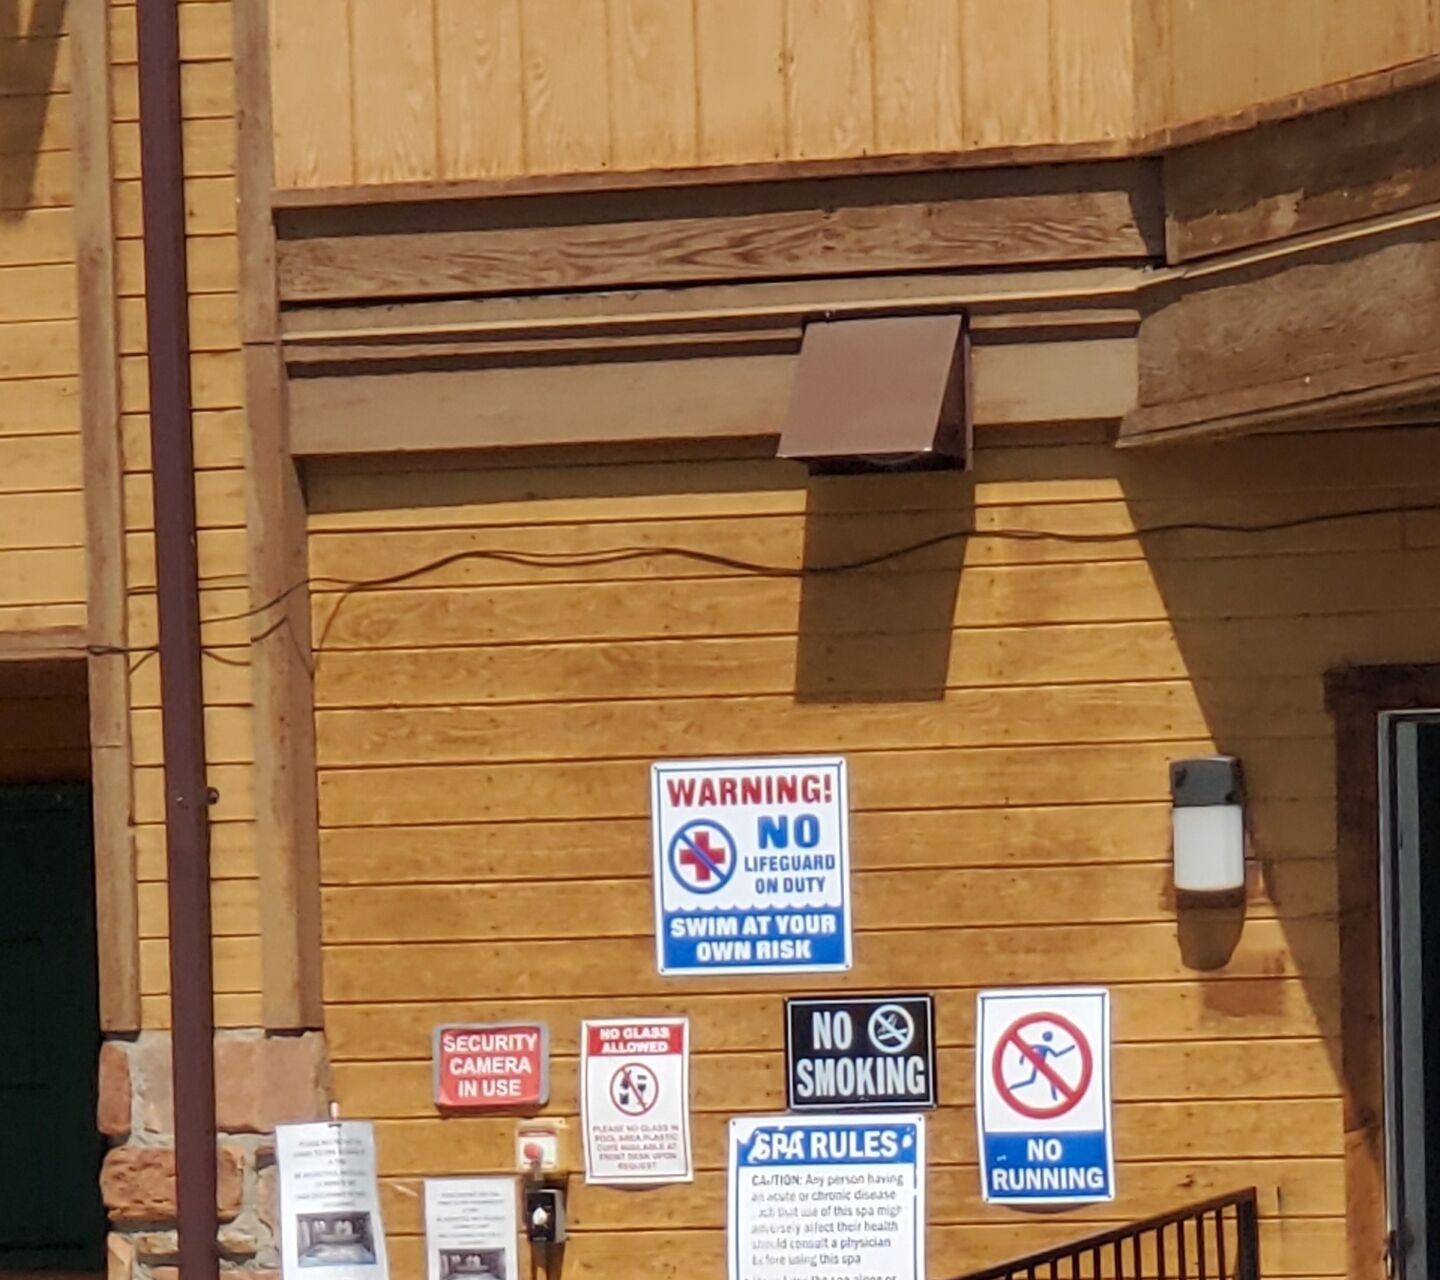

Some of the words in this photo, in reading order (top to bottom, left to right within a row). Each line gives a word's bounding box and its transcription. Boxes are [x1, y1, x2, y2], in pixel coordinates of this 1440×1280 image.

[666, 774, 832, 807] WARNING!
[757, 814, 820, 849] NO
[744, 854, 835, 872] LIFEGUARD
[755, 877, 777, 894] ON
[783, 876, 826, 893] DUTY
[670, 917, 739, 937] SWIM
[742, 916, 772, 935] AT
[775, 914, 836, 934] YOUR
[696, 942, 750, 961] OWN
[756, 940, 811, 960] RISK
[600, 1028, 620, 1040] NO
[622, 1026, 671, 1039] GLASS
[812, 1010, 853, 1050] NO
[443, 1033, 538, 1052] SECURITY
[601, 1041, 669, 1054] ALLOWED
[449, 1056, 532, 1075] CAMERA
[796, 1055, 926, 1097] SMOKING
[458, 1078, 477, 1097] IN
[483, 1079, 522, 1097] USE
[753, 1131, 805, 1160] SPA
[810, 1130, 898, 1159] RULES
[1027, 1138, 1063, 1162] NO
[827, 1175, 865, 1188] person
[867, 1172, 904, 1187] having
[991, 1166, 1105, 1191] RUNNING
[798, 1191, 810, 1201] or
[811, 1189, 851, 1201] chronic
[854, 1188, 896, 1200] disease
[821, 1205, 832, 1217] of
[834, 1205, 853, 1217] this
[855, 1206, 874, 1219] spa
[837, 1221, 862, 1233] their
[864, 1220, 898, 1233] health
[831, 1239, 838, 1249] a
[840, 1236, 891, 1251] physician
[819, 1253, 839, 1265] this
[841, 1254, 862, 1267] spa
